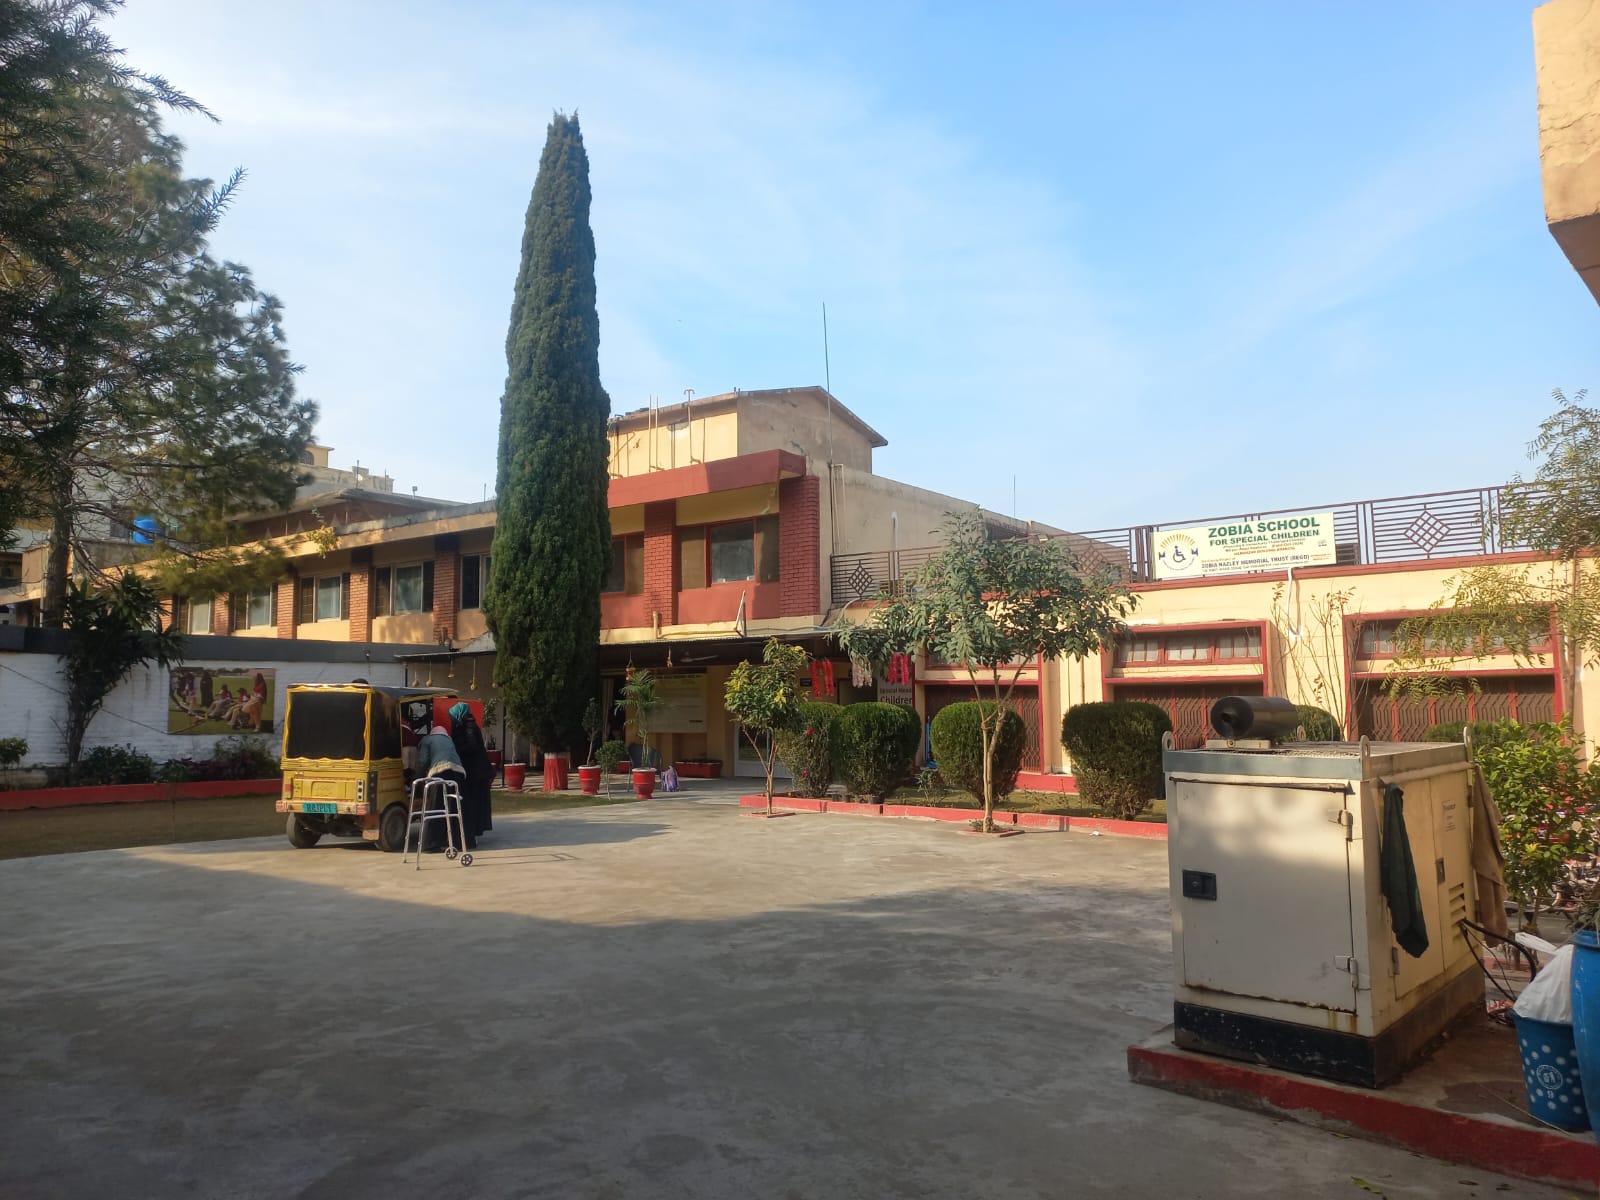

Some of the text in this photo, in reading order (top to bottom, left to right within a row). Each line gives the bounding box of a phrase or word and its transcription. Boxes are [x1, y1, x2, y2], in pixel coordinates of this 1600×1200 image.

[1208, 517, 1320, 538] ZOBIA SCHOOL
[1210, 538, 1228, 547] FOR
[1230, 535, 1268, 544] SPECIAL
[1271, 529, 1320, 541] CHILDREN
[1240, 557, 1269, 566] MEMORIAL
[1270, 555, 1289, 563] TRUST
